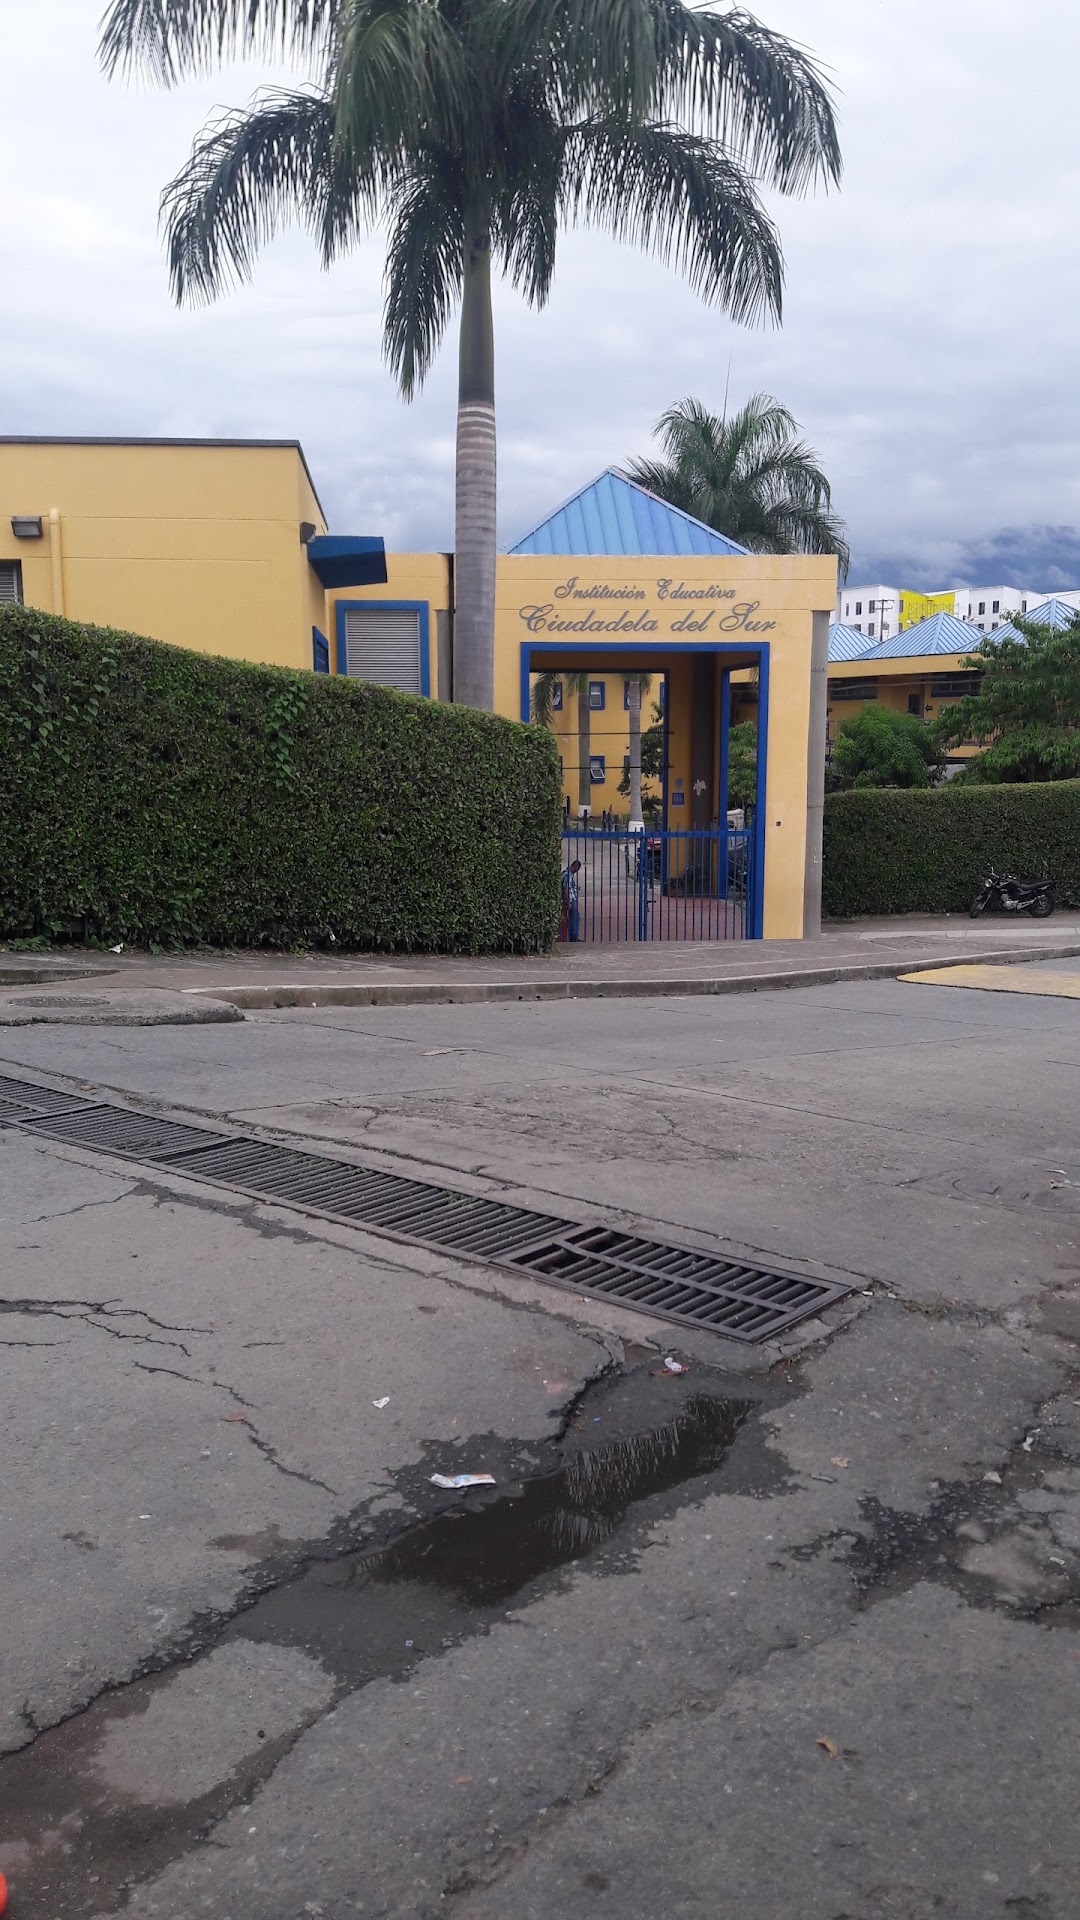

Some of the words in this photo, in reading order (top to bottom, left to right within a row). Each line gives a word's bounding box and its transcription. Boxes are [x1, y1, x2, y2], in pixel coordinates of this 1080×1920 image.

[554, 576, 646, 599] Institución
[656, 579, 736, 600] Educativa
[519, 603, 658, 633] Ciudadela
[670, 610, 715, 632] del
[719, 601, 777, 632] Sur
